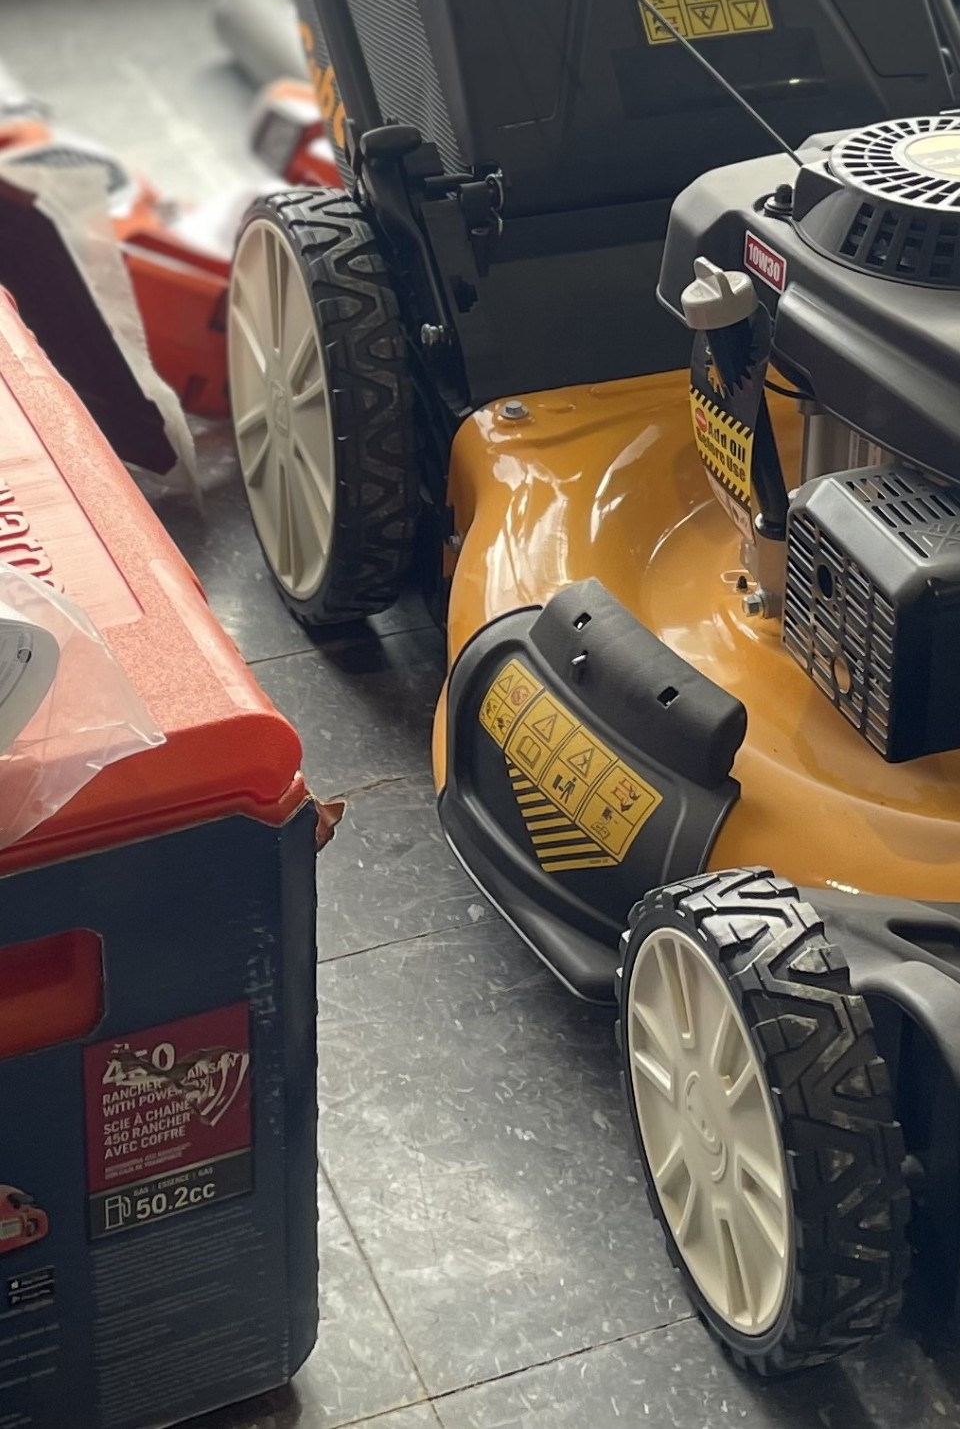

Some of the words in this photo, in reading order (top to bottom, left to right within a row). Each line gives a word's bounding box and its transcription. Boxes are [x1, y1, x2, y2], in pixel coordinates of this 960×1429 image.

[748, 243, 780, 282] 10W30
[708, 421, 727, 449] Add
[730, 438, 746, 463] Oil
[727, 455, 746, 482] Use
[103, 1101, 136, 1117] WITH
[103, 1118, 131, 1135] SCIE
[134, 1112, 143, 1126] À
[145, 1100, 191, 1122] CHAÎNE
[104, 1131, 129, 1147] 450
[132, 1113, 192, 1136] RANCHER
[104, 1141, 138, 1160] AVEC
[140, 1125, 186, 1148] COFFRE
[157, 1174, 190, 1190] ESSENCE
[136, 1183, 216, 1220] 50.2cc
